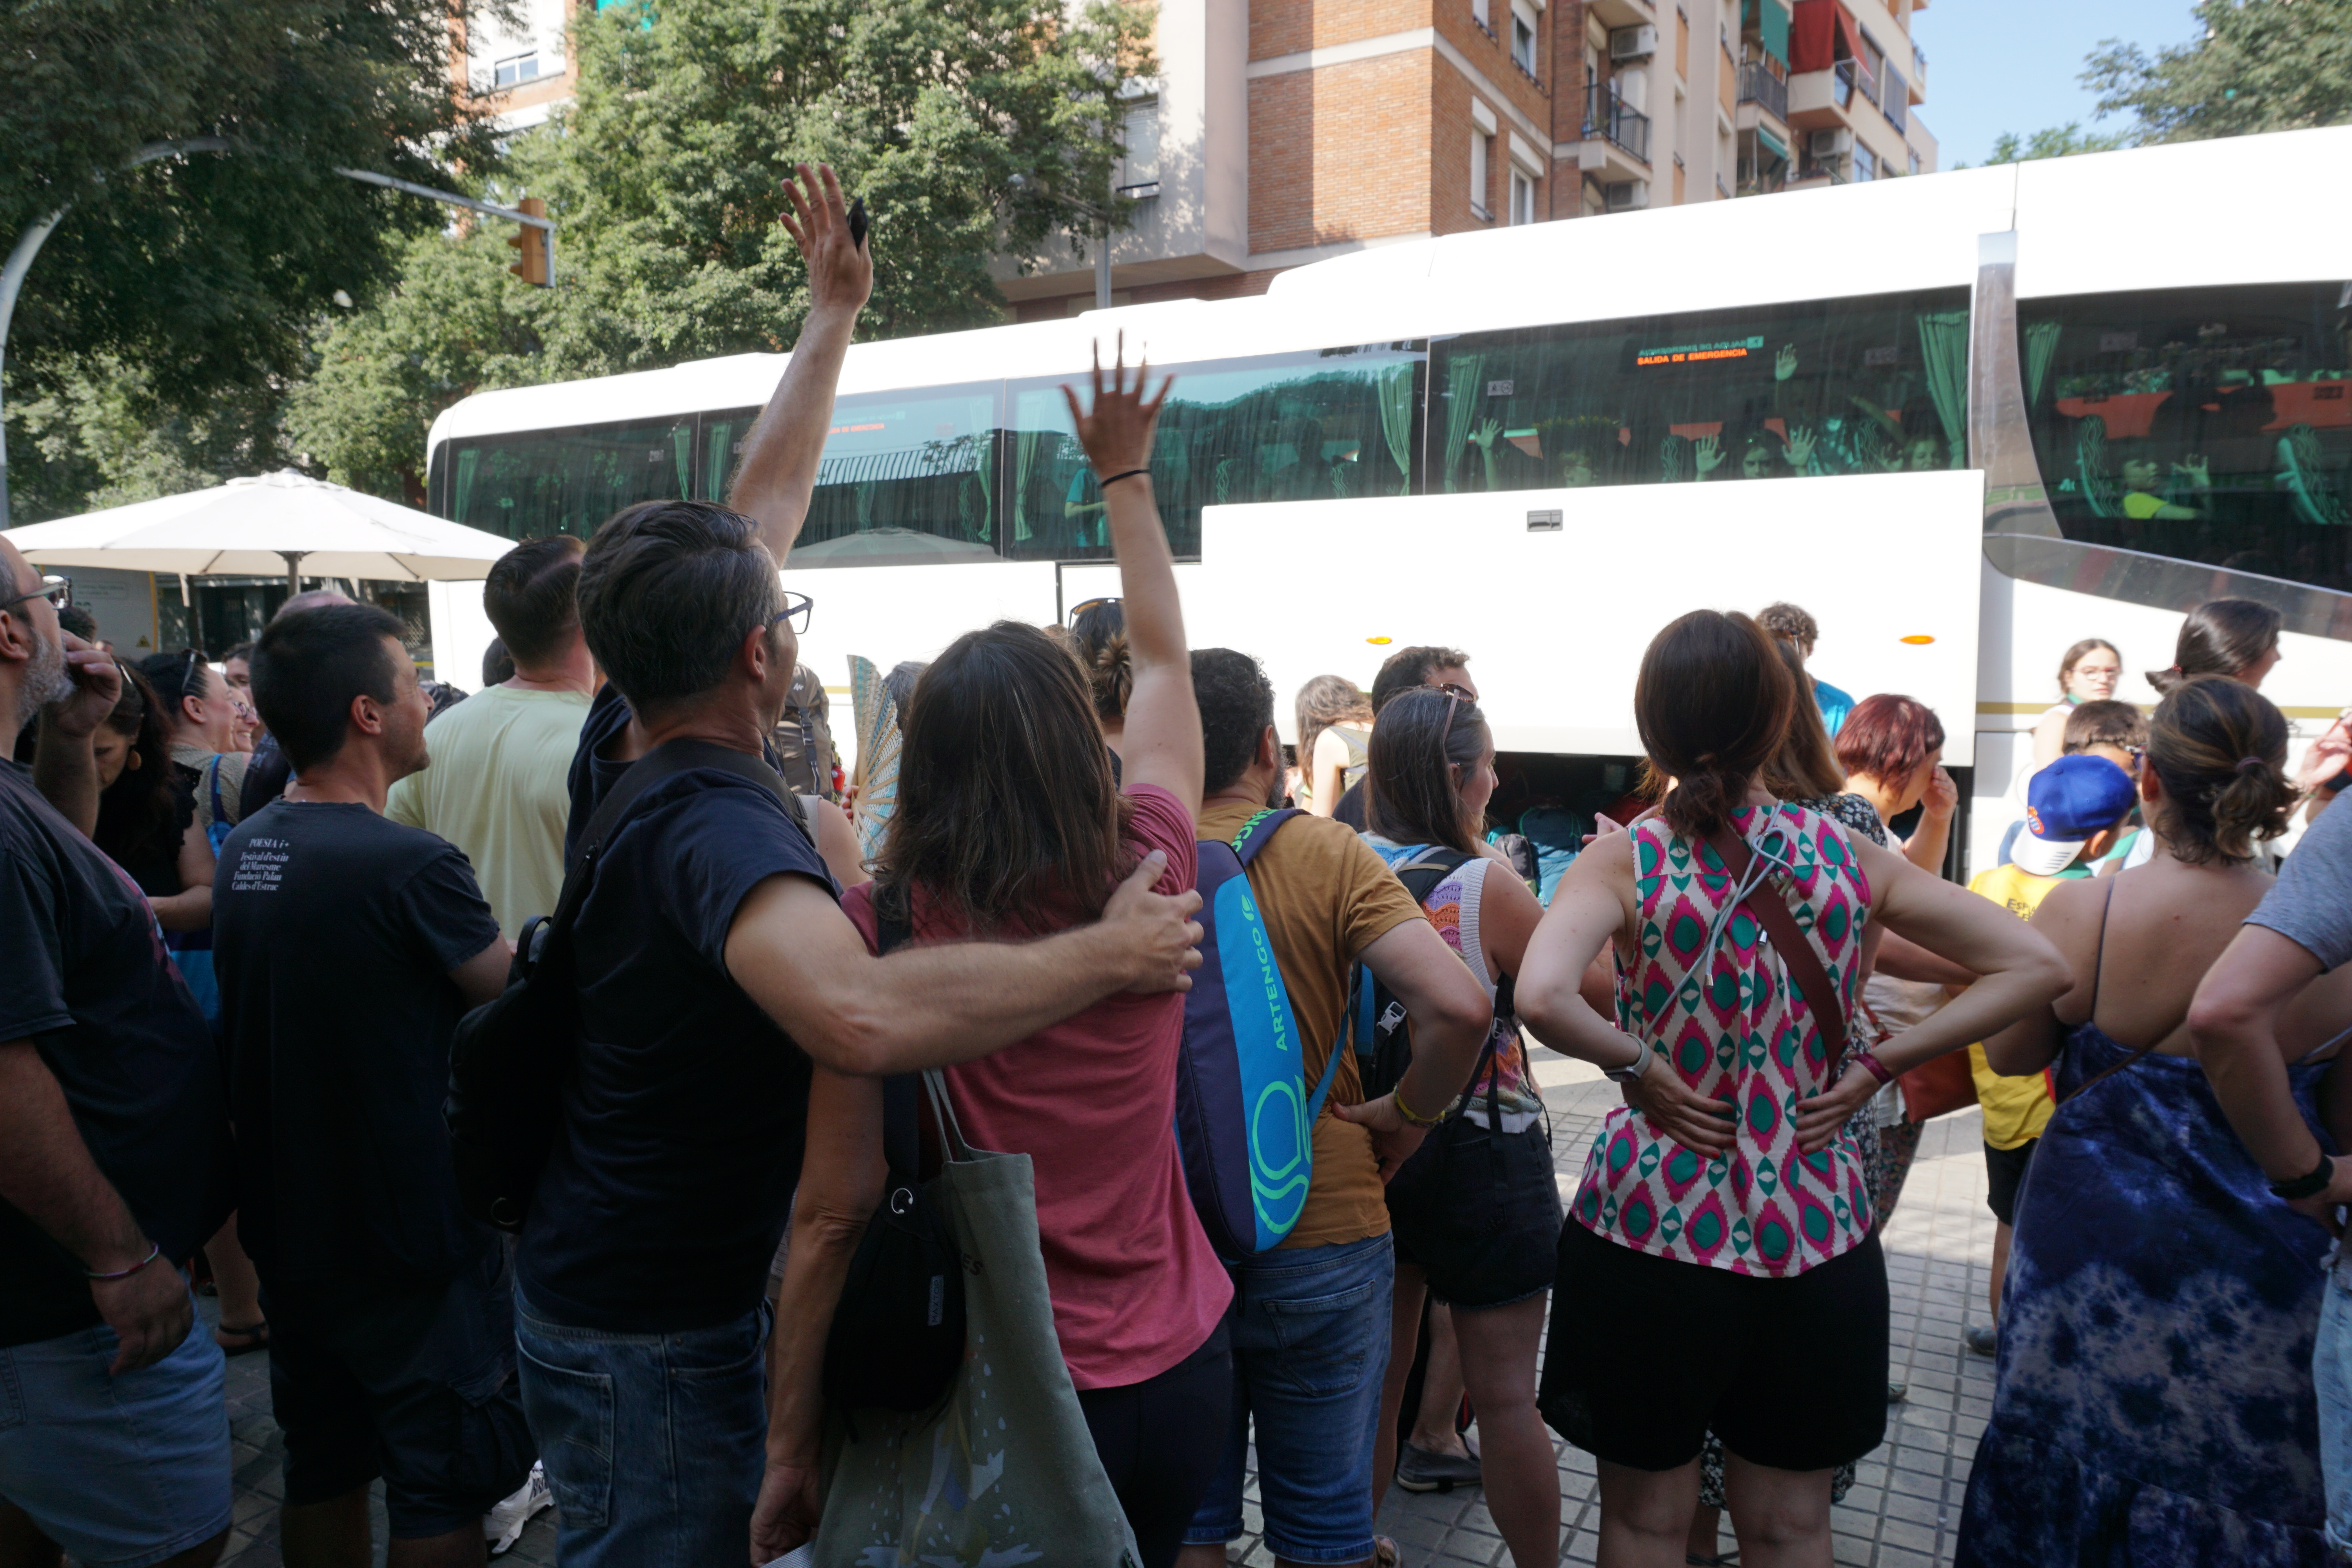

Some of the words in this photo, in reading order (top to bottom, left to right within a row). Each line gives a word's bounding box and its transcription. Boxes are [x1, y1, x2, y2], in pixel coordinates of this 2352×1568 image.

[1637, 355, 1669, 365] SALIDA
[1672, 354, 1685, 362] DE
[1688, 348, 1747, 361] EMERGENCIA
[249, 838, 278, 848] POESIA
[240, 851, 265, 861] Festival
[240, 861, 250, 871] del
[251, 861, 281, 871] Maresme
[234, 871, 261, 880] Fundació
[262, 871, 283, 881] Palau
[232, 881, 252, 891] Caldes
[1252, 927, 1288, 1051] ARTENGO
